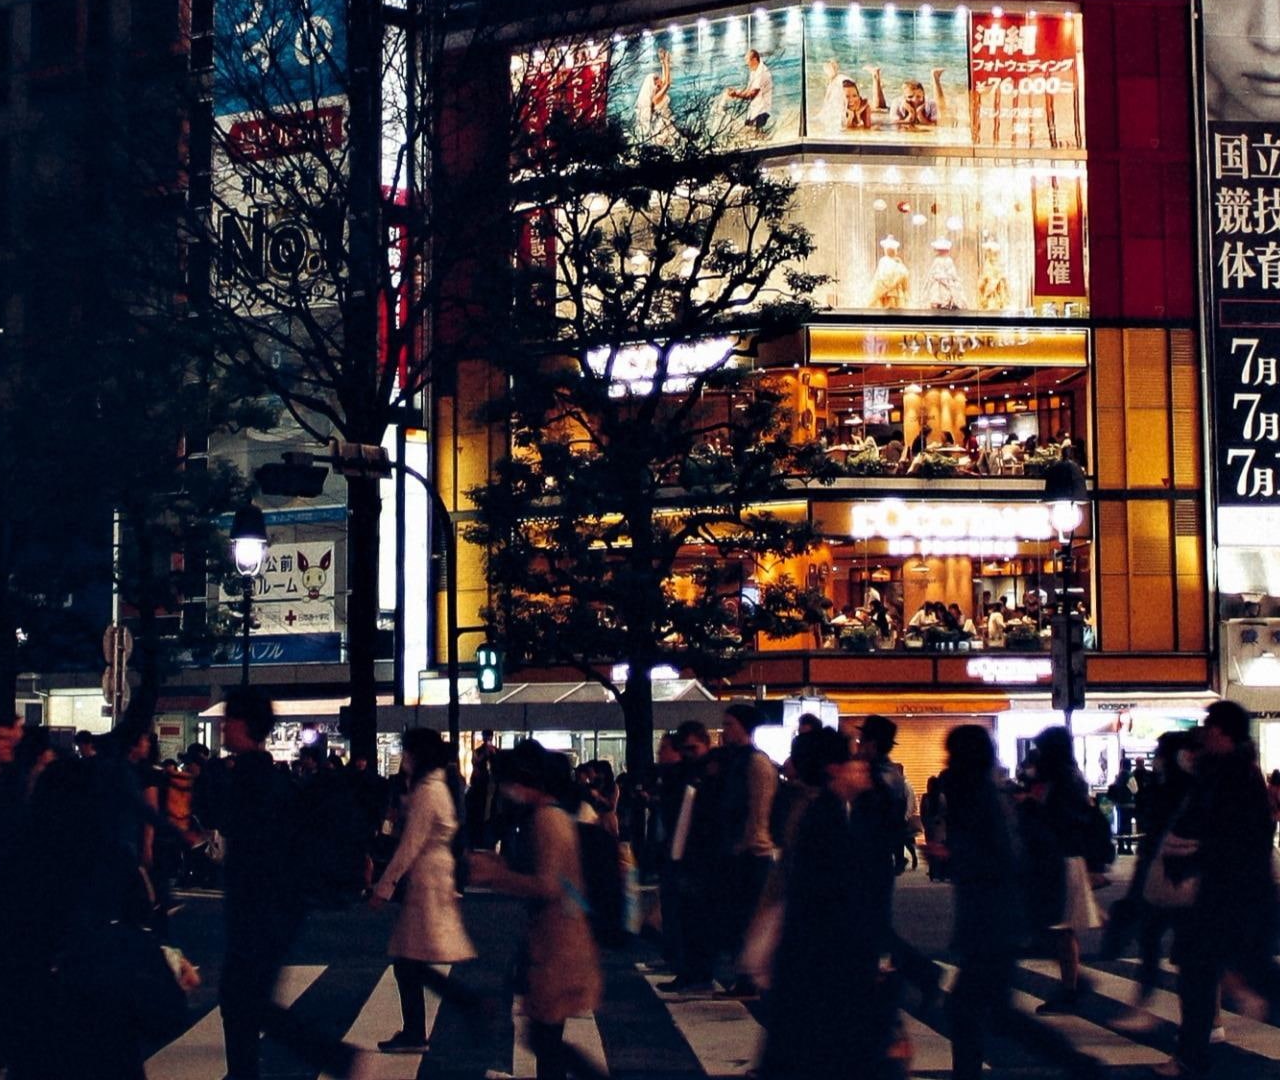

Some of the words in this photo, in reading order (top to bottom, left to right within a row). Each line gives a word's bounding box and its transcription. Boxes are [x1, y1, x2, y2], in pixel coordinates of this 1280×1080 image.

[972, 23, 1038, 56] 沖縄
[1046, 194, 1071, 286] 日開催
[258, 578, 298, 595] ルーム
